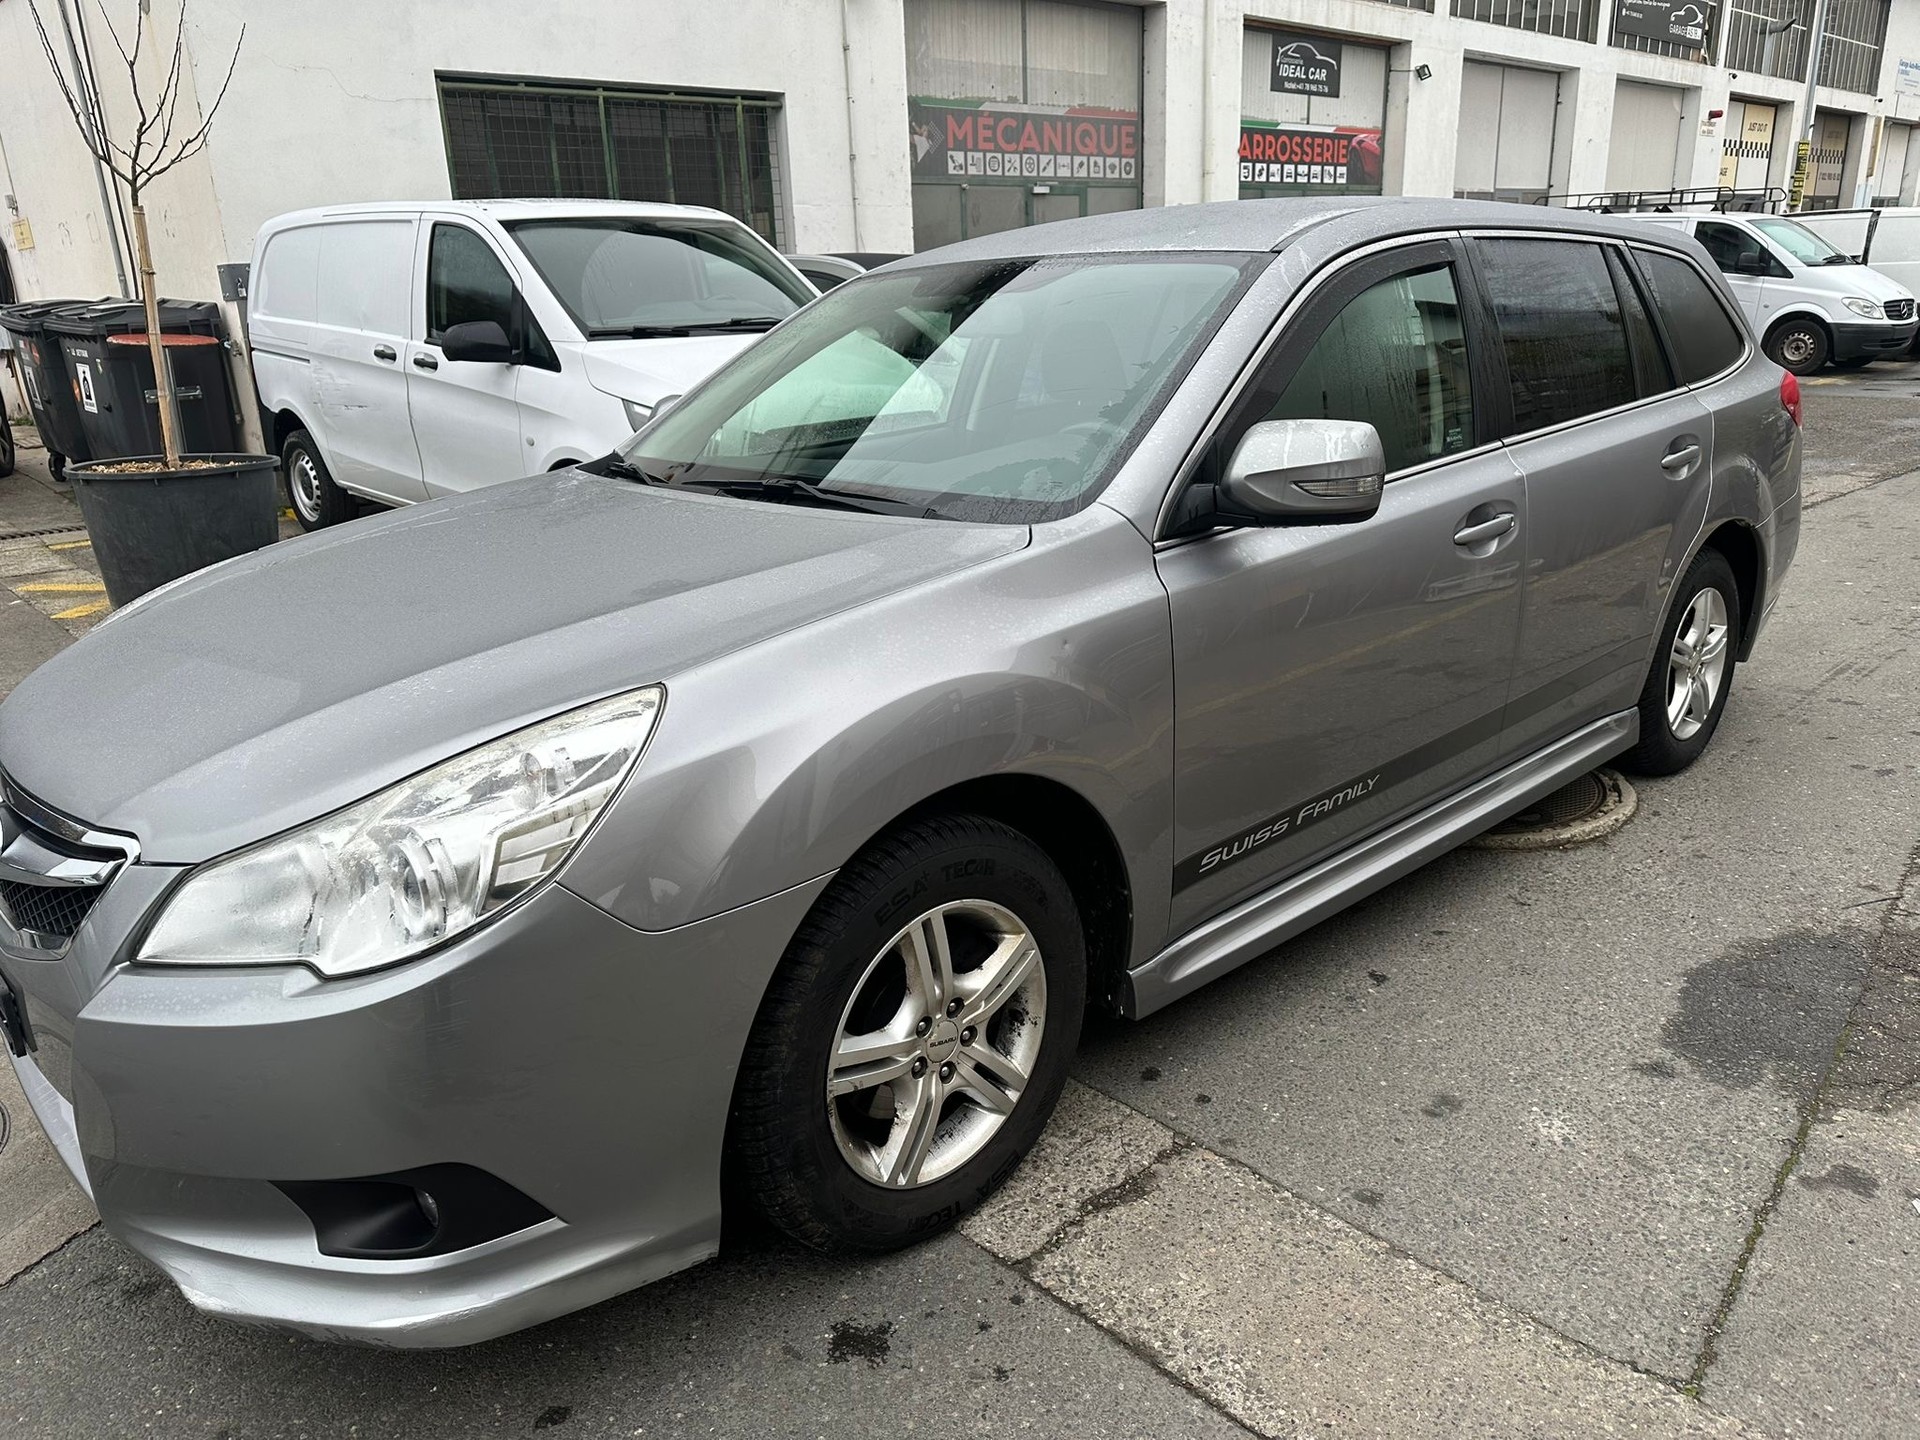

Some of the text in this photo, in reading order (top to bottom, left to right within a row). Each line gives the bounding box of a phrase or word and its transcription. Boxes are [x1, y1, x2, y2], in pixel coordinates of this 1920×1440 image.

[1279, 64, 1327, 81] IDEAL CAR
[946, 112, 1136, 156] MÉCANIQUE
[1239, 134, 1347, 162] ARROSSERIE
[1198, 774, 1380, 873] SWISS FAMILY
[929, 1036, 957, 1048] SUBARU
